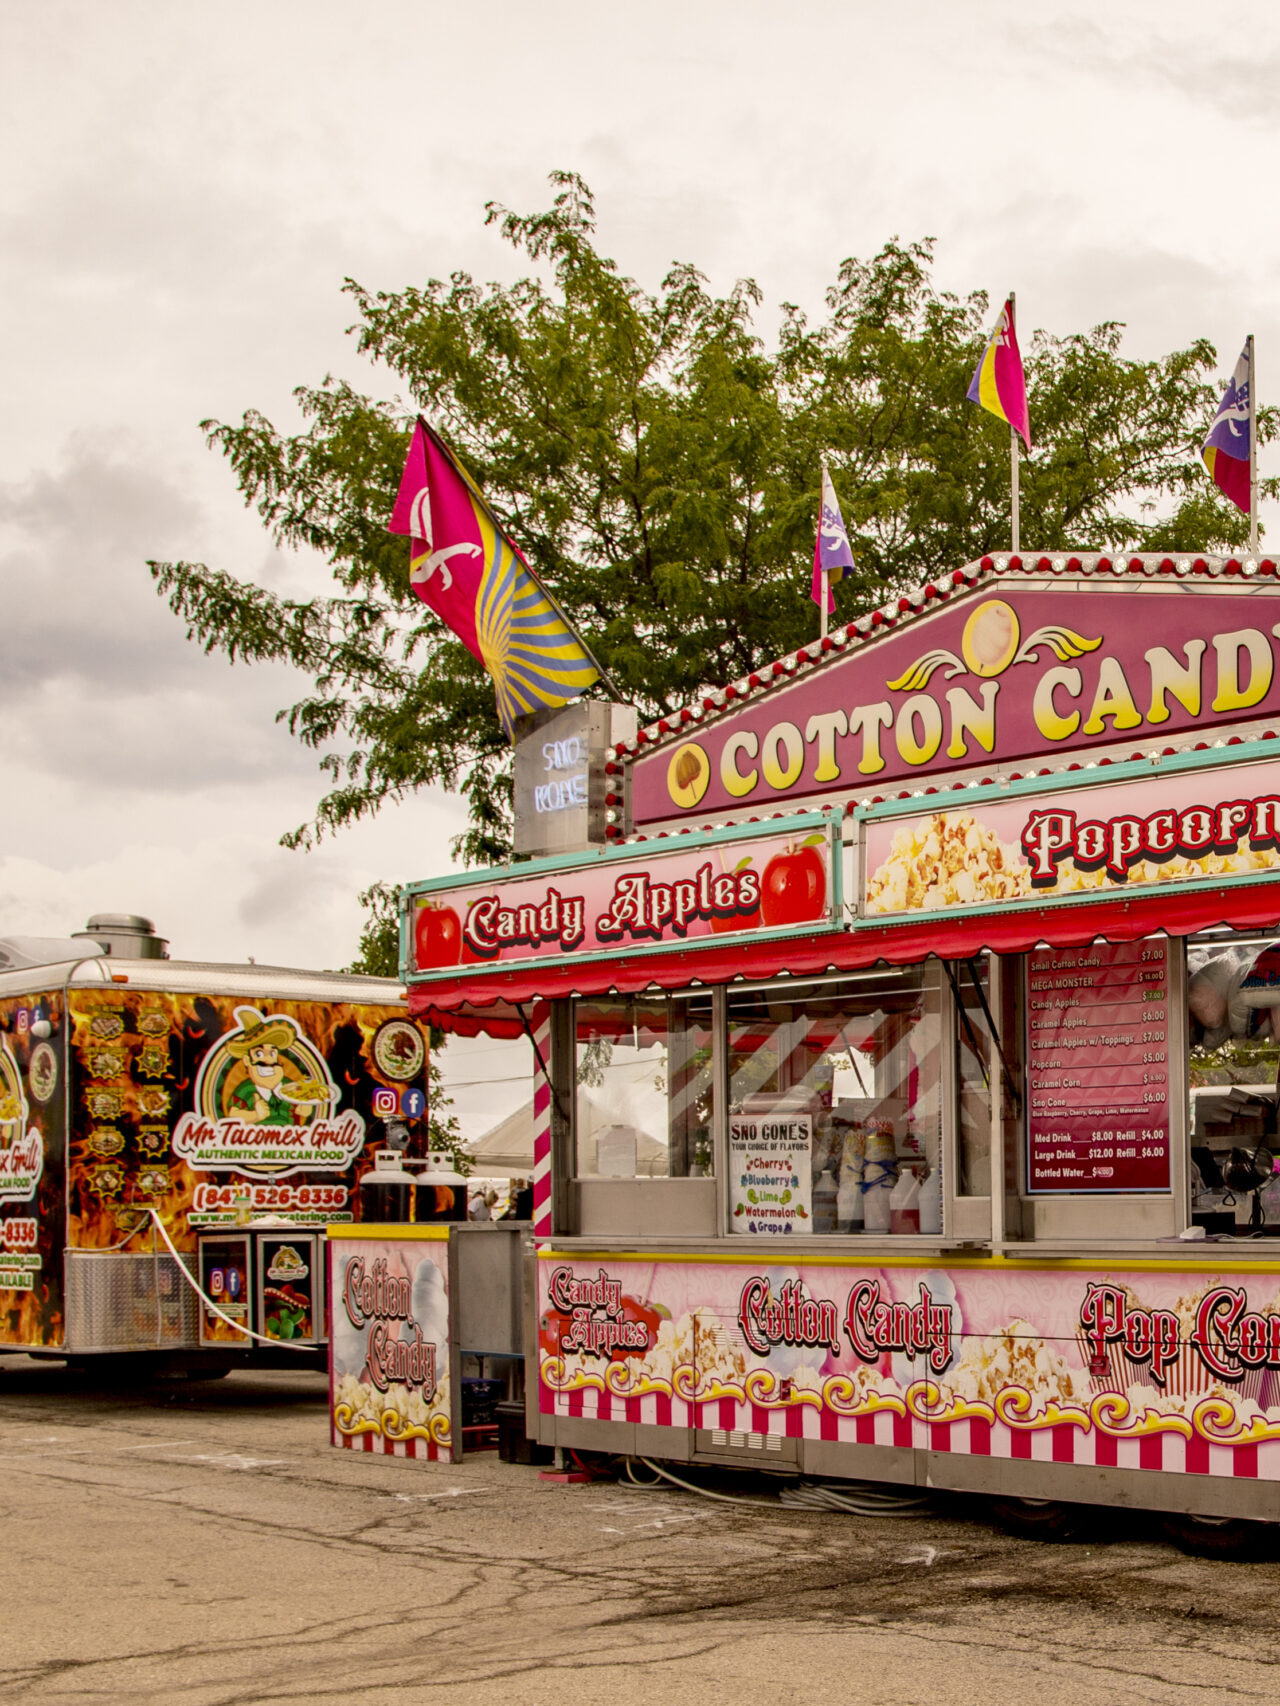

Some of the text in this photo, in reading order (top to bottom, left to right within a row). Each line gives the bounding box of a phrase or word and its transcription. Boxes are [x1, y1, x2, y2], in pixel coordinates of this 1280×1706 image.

[719, 681, 1000, 797] COTTON
[542, 736, 580, 771] SNO
[464, 862, 761, 950] Candy Apples
[1031, 950, 1164, 972] Small Cotton Candy $7.00
[1031, 980, 1053, 991] MEGA
[1055, 978, 1093, 990] MONSTER
[1031, 999, 1052, 1011] Candy
[1055, 997, 1080, 1009] Apples
[1031, 1020, 1060, 1030] Caramel
[1063, 1018, 1087, 1029] Apples
[1031, 1039, 1060, 1049] Caramel
[1063, 1037, 1087, 1049] Apples
[1101, 1034, 1134, 1047] Toppings
[1142, 1031, 1165, 1043] $7.00
[1031, 1051, 1165, 1071] Popcorn $5.00
[1032, 1080, 1061, 1089] Caramel
[1063, 1078, 1081, 1088] Corn
[1032, 1092, 1166, 1107] Sno Cone $6.00
[182, 1119, 357, 1148] Mr. Tacomex Grill
[731, 1122, 808, 1140] SNO CONES
[1035, 1129, 1164, 1143] Med Drink $8.00 Refill $4.00
[11, 1139, 38, 1175] Grill
[197, 1149, 344, 1160] AUTHENTIC MEXICAN FOOD
[1035, 1146, 1164, 1162] Large Drink $12.00 Refill $6.00
[754, 1157, 783, 1170] Cherry
[1035, 1168, 1060, 1178] Bottled
[1062, 1167, 1084, 1178] Water
[13, 1178, 30, 1188] FOOD
[748, 1174, 790, 1187] Blueberry
[255, 1187, 345, 1206] 526-8336
[760, 1190, 779, 1202] Lime
[745, 1205, 796, 1218] Watermelon
[758, 1221, 782, 1234] Grape
[343, 1256, 414, 1327] Cotton
[549, 1267, 622, 1315] Candy
[561, 1308, 649, 1354] Apples
[738, 1276, 955, 1375] Cotton Candy
[1079, 1282, 1180, 1382] Pop
[367, 1320, 437, 1402] Candy
